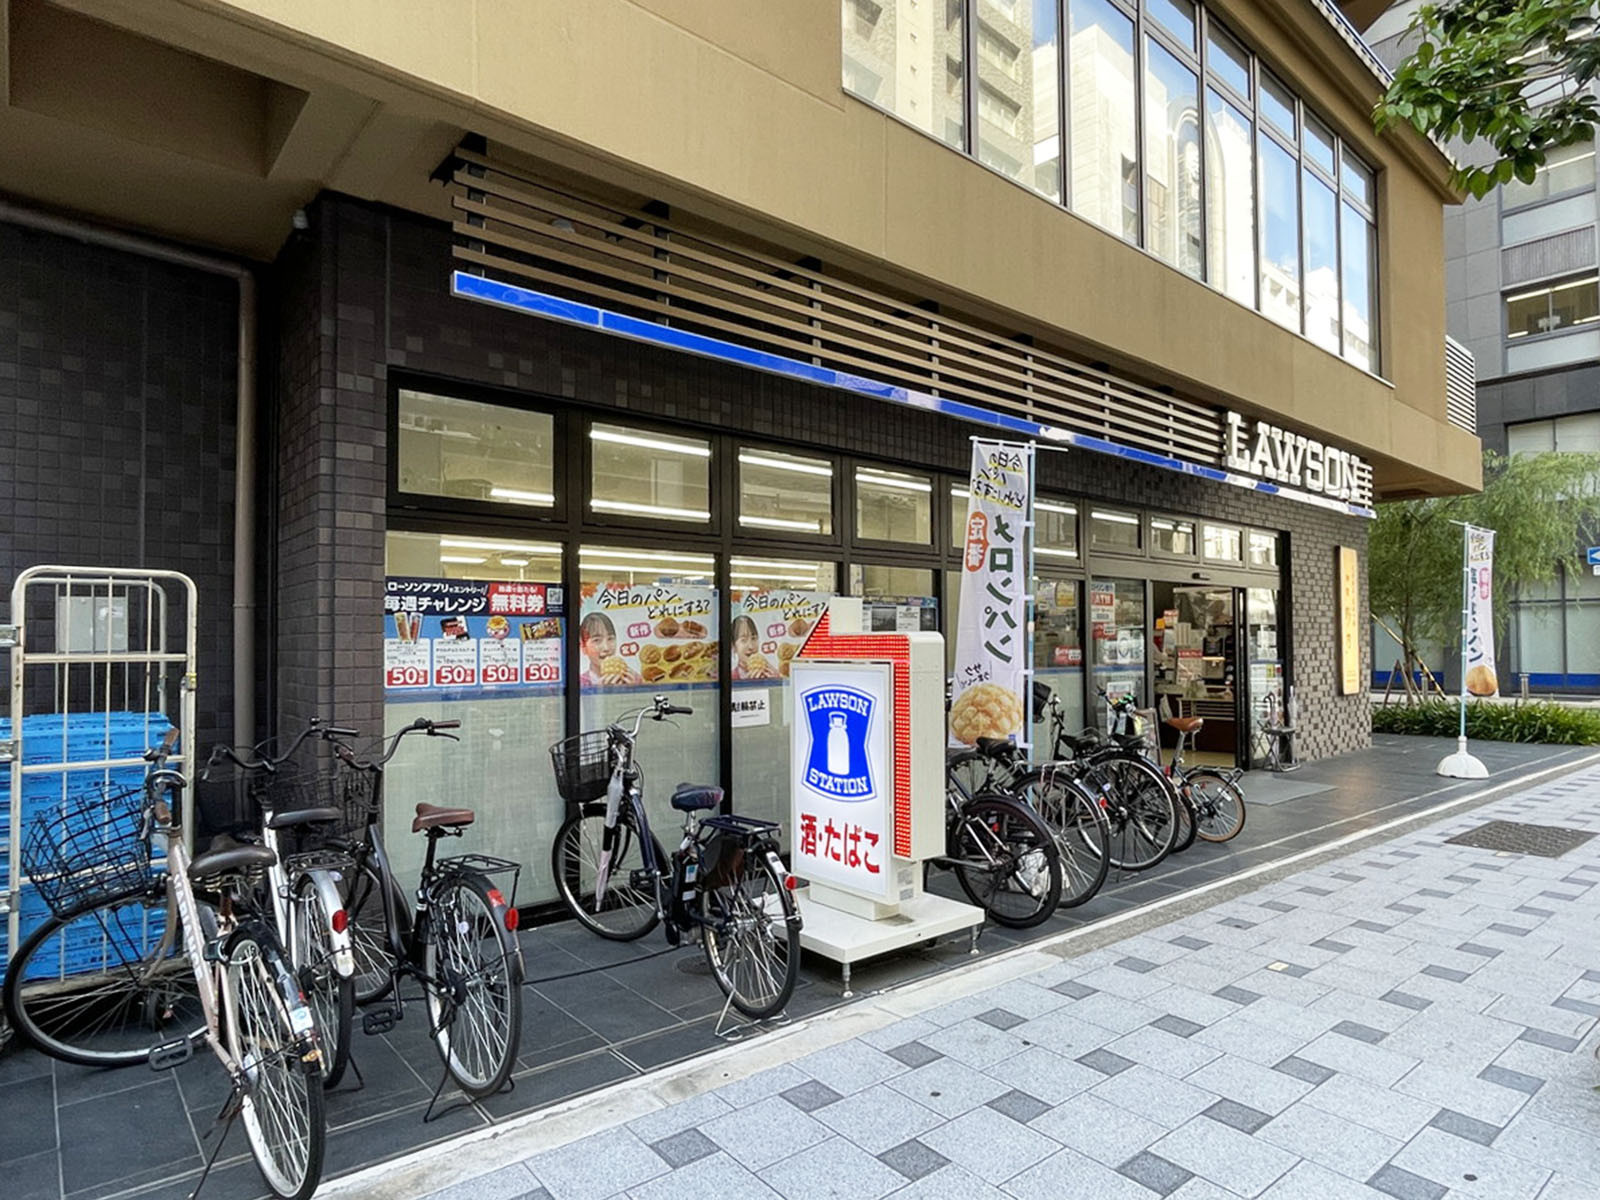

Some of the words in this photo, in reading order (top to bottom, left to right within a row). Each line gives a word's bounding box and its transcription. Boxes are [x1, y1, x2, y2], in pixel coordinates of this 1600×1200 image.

[1227, 410, 1361, 501] LAWSON
[384, 595, 487, 613] 毎週チャレンジ
[491, 594, 545, 613] 無料券
[647, 599, 711, 620] どれにする?
[807, 692, 869, 716] LAWSON
[808, 767, 869, 794] STATION
